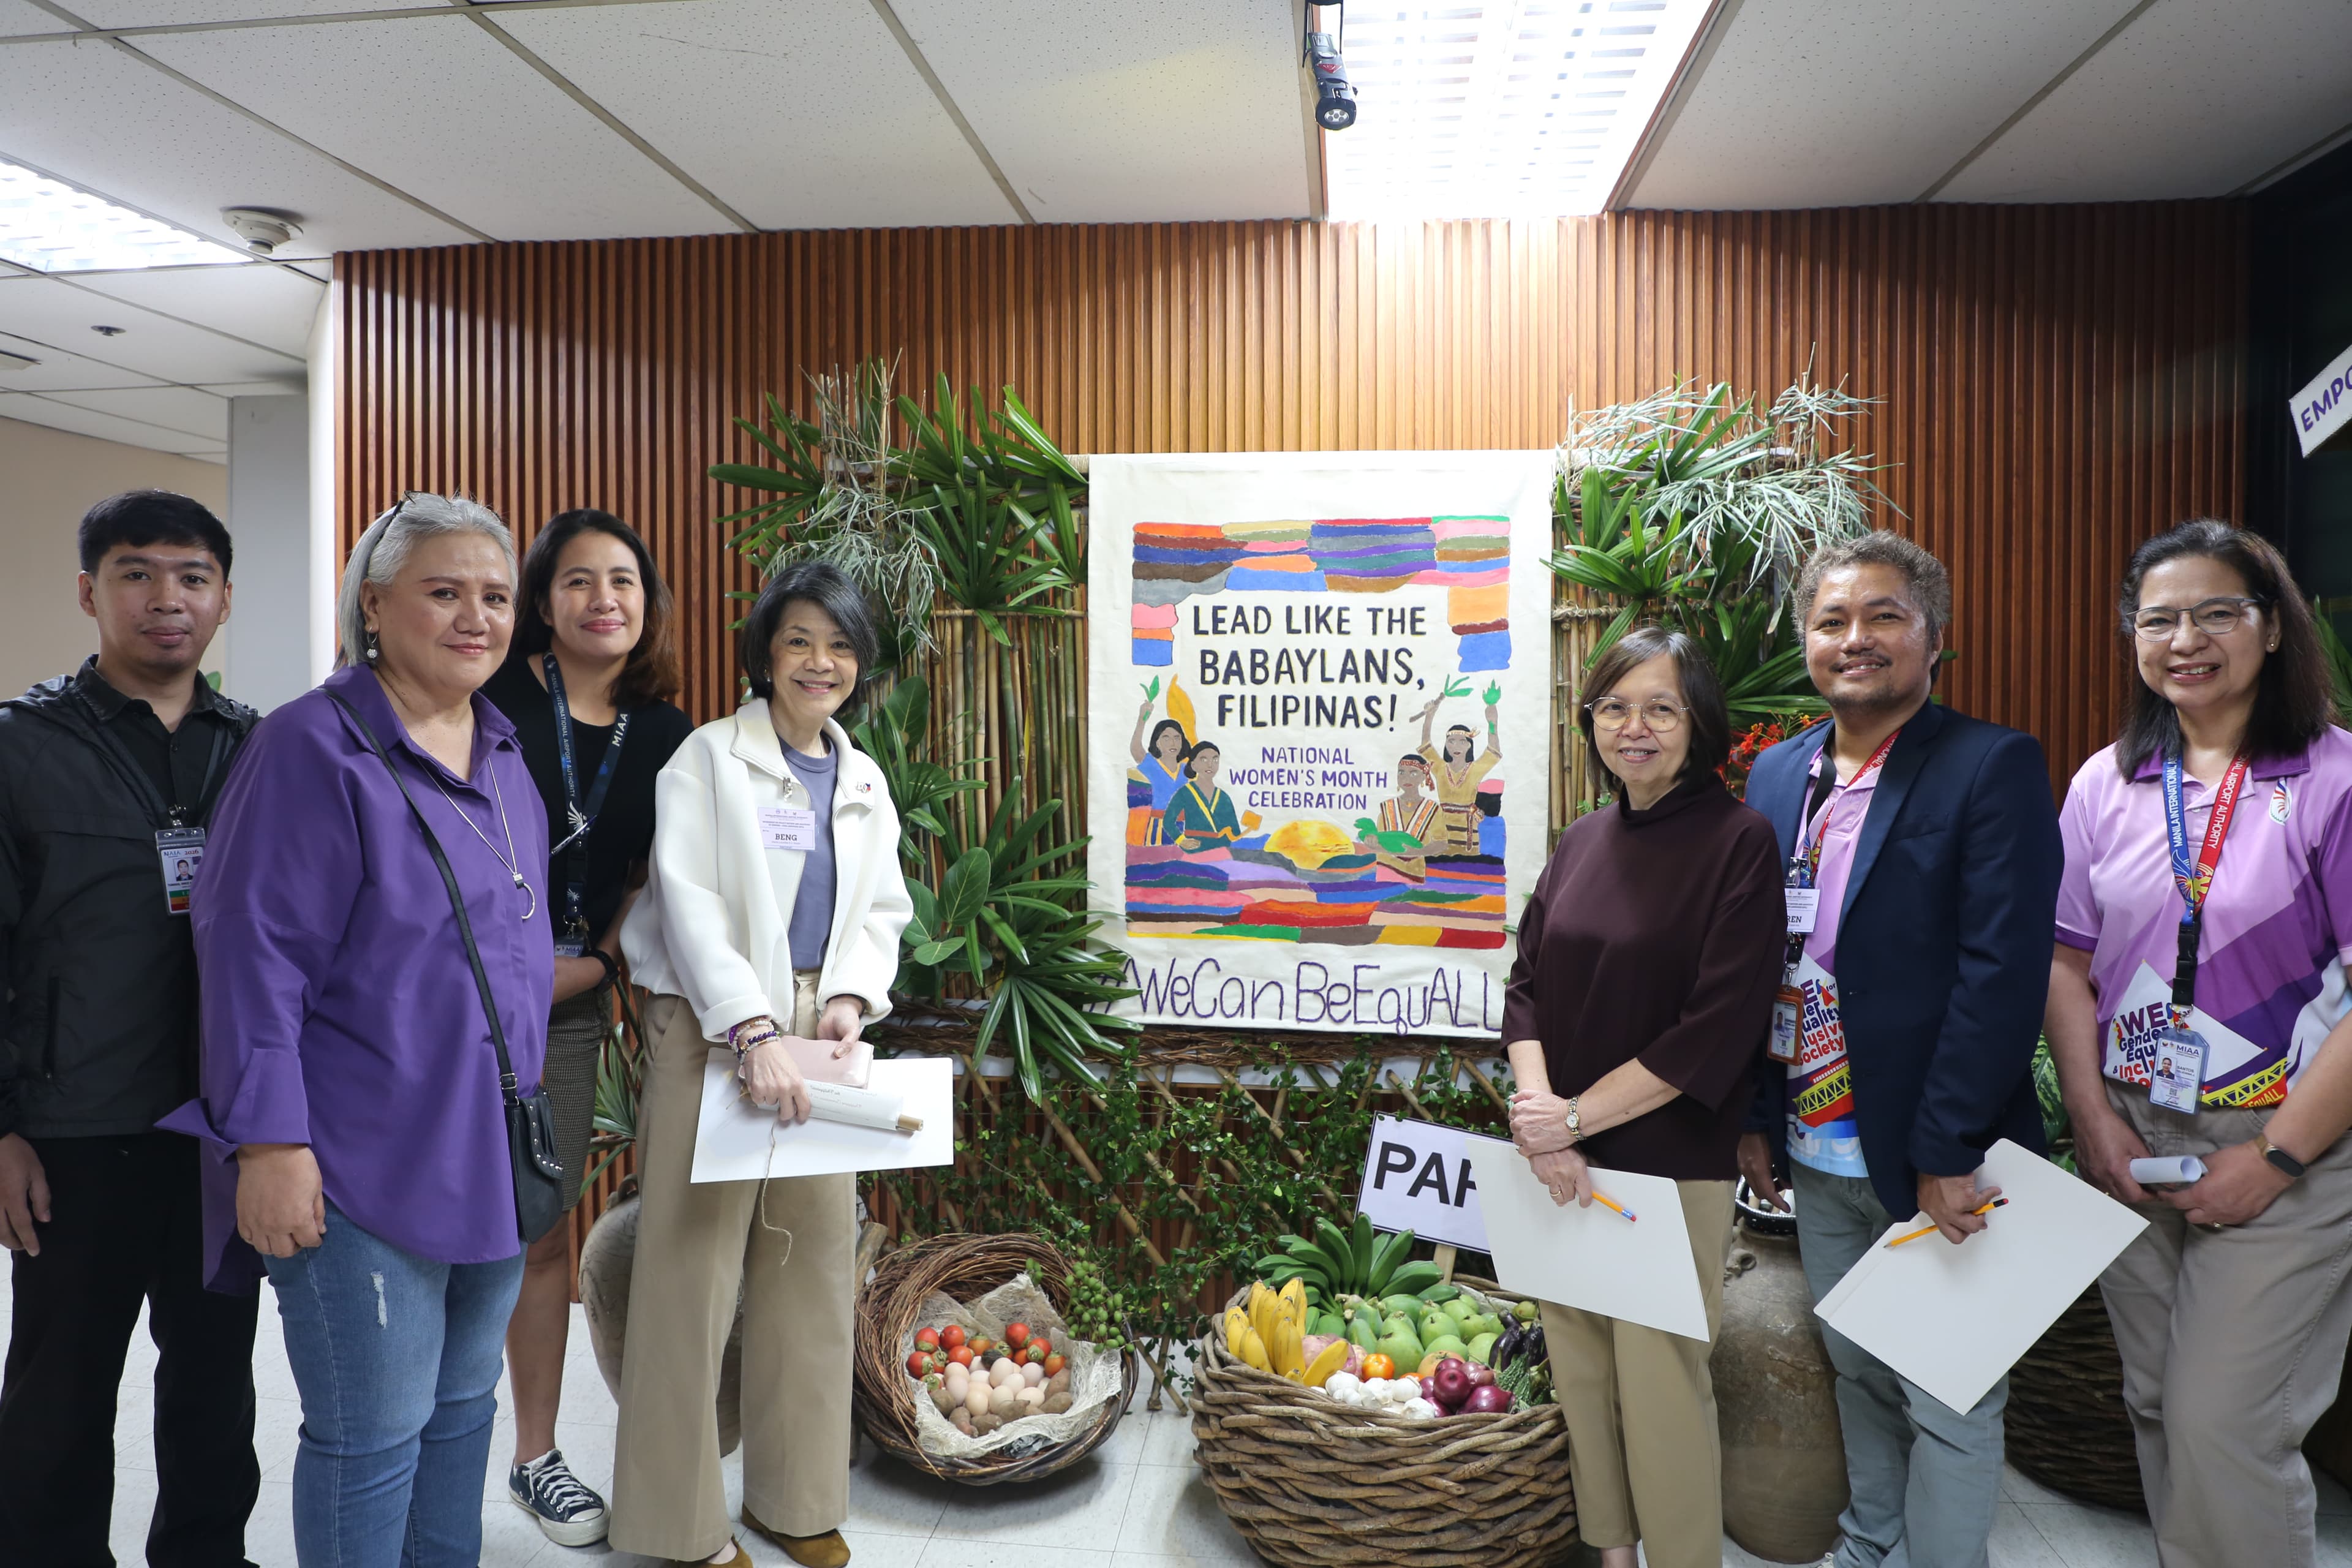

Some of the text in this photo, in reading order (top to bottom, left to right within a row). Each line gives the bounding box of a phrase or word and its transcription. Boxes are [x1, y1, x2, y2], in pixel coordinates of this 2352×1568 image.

[1194, 605, 1426, 635] LEAD LIKE THE
[1200, 648, 1424, 690] BABAYLANS,
[1218, 695, 1396, 731] FILIPINAS!
[556, 694, 568, 737] INTERNATIONAL
[567, 764, 575, 797] AUTHORITY
[612, 713, 628, 747] MIAA
[1262, 747, 1354, 764] NATIONAL
[1230, 769, 1387, 787] WOMEN'S MONTH
[2166, 765, 2179, 819] INTERNATIONAL
[2220, 772, 2239, 805] AIRPORT
[1249, 791, 1366, 809] CELEBRATION
[2171, 818, 2184, 848] MANILA
[2207, 804, 2228, 849] AUTHORITY
[2120, 1001, 2168, 1036] WE
[2176, 1044, 2199, 1056] MIAA
